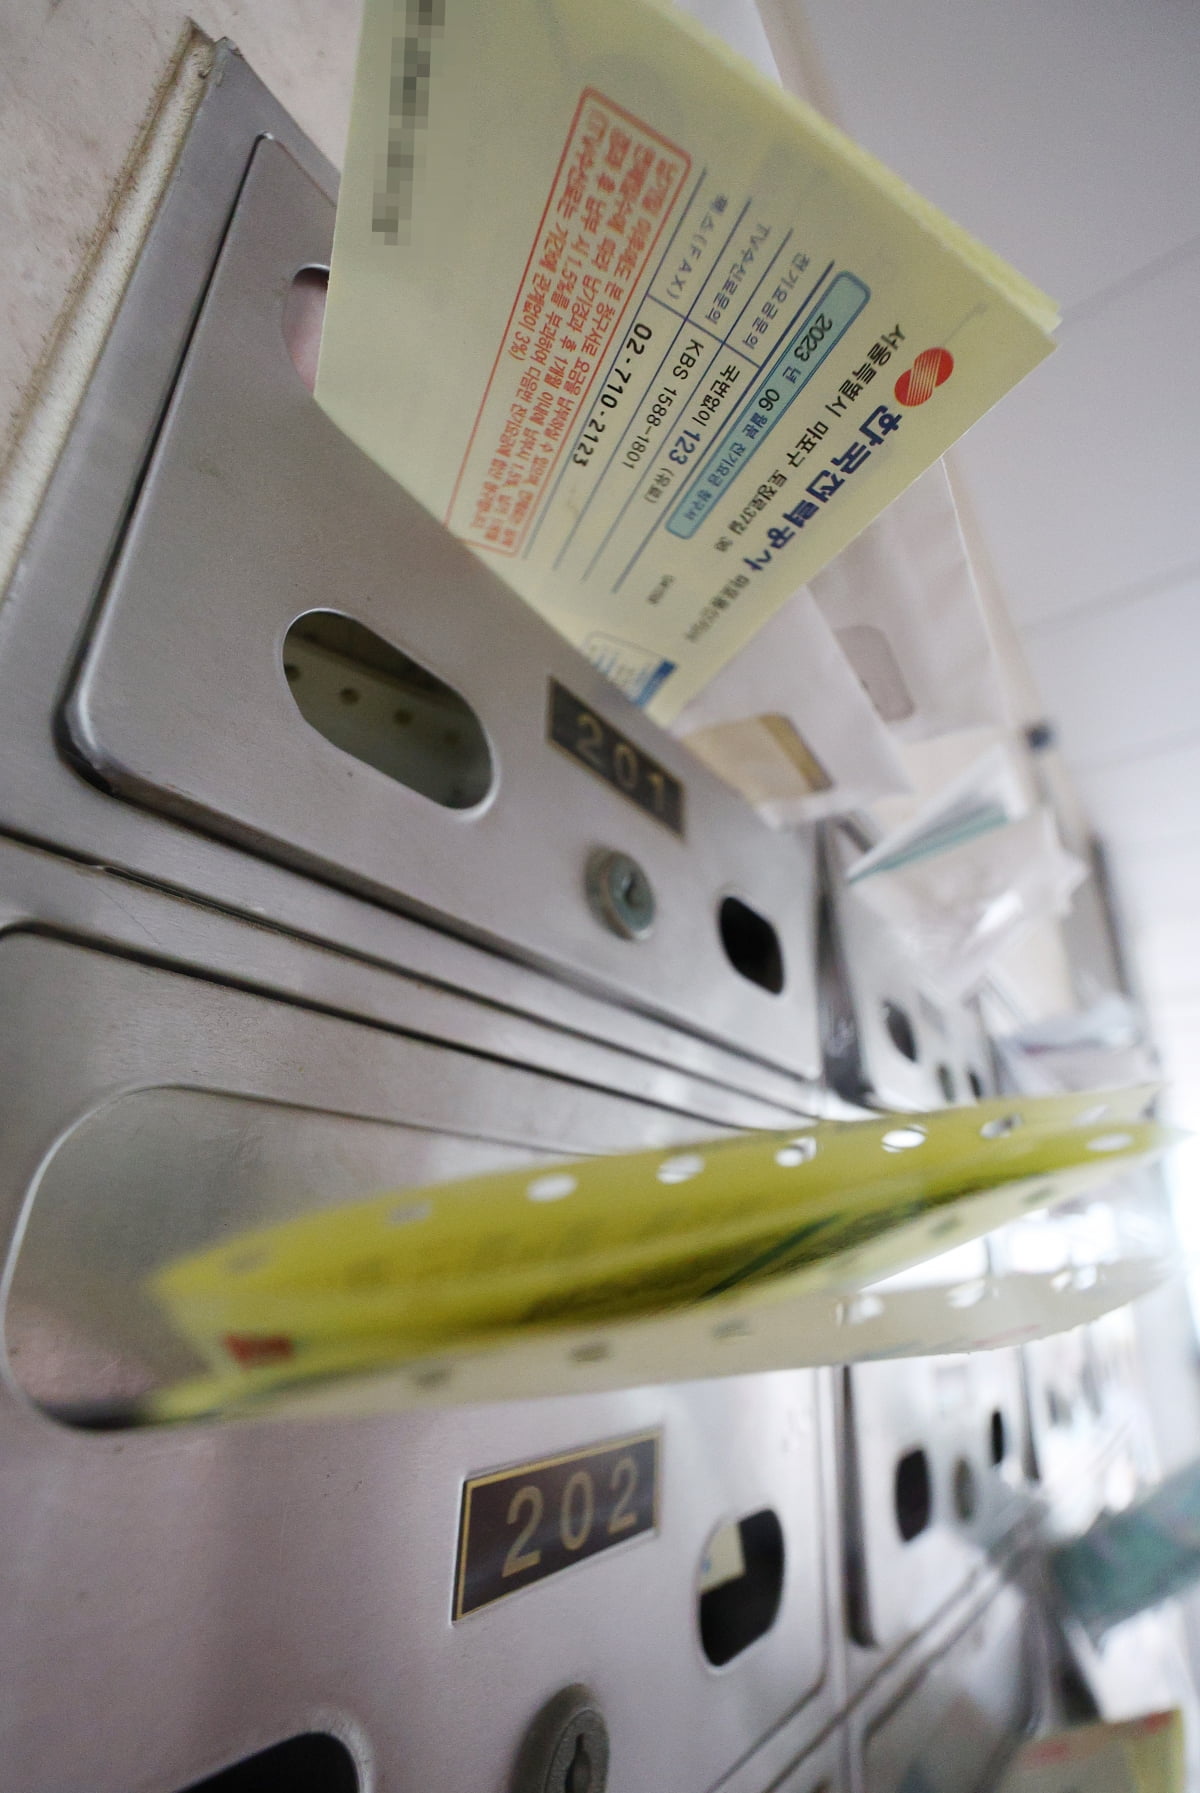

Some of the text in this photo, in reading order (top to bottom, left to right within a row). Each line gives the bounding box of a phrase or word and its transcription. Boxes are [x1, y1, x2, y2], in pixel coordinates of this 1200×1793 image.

[570, 233, 590, 260] 시
[603, 280, 625, 302] 본
[704, 224, 770, 325] TV수신료문의
[518, 272, 552, 333] 관계없이
[566, 274, 602, 333] 납기경과
[742, 253, 810, 350] 전기요금문의
[507, 331, 531, 362] 3%)
[530, 311, 563, 366] 부과하여
[559, 335, 577, 353] 후
[580, 302, 616, 358] 청구서로
[793, 313, 833, 362] 2023
[515, 366, 542, 404] 다음번
[543, 356, 569, 390] 1개월
[563, 356, 590, 396] 요금을
[573, 323, 652, 467] 02-710-2123
[782, 365, 802, 384] 년
[825, 324, 905, 418] 서울특별시
[528, 391, 554, 427] 이내에
[543, 396, 575, 442] 납부하실
[623, 339, 704, 469] KBS 1588-1801
[538, 441, 555, 454] 수
[643, 365, 740, 504] 국번없이 123 (유료)
[786, 421, 829, 468] 마포구
[707, 441, 747, 487] 전기요금
[744, 406, 901, 570] 한국전력공사
[684, 489, 713, 521] 청구서
[728, 469, 787, 535] 토정로37길
[575, 711, 667, 813] 201
[500, 1456, 639, 1579] 202
